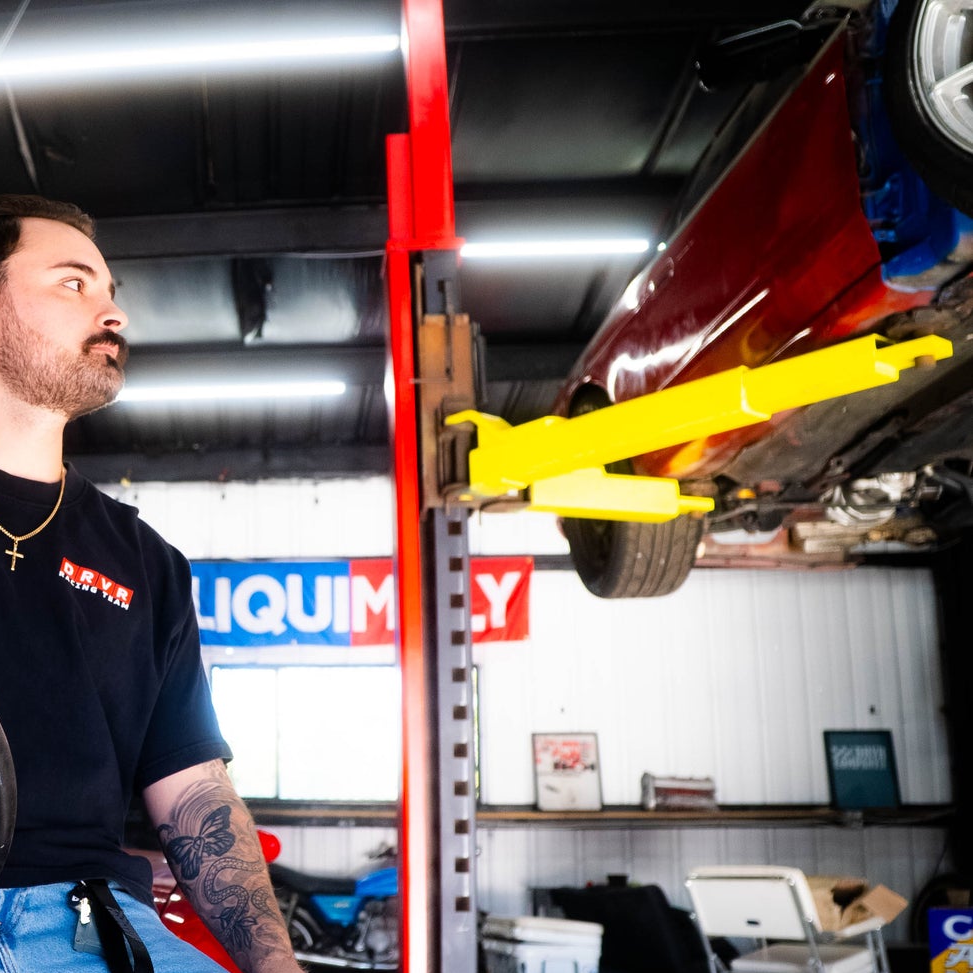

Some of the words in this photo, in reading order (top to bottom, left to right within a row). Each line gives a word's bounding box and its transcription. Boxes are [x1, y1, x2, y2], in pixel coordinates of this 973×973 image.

[58, 570, 98, 593] RACING
[102, 591, 129, 610] TEAM
[64, 562, 128, 601] DRVR
[351, 571, 522, 633] MY
